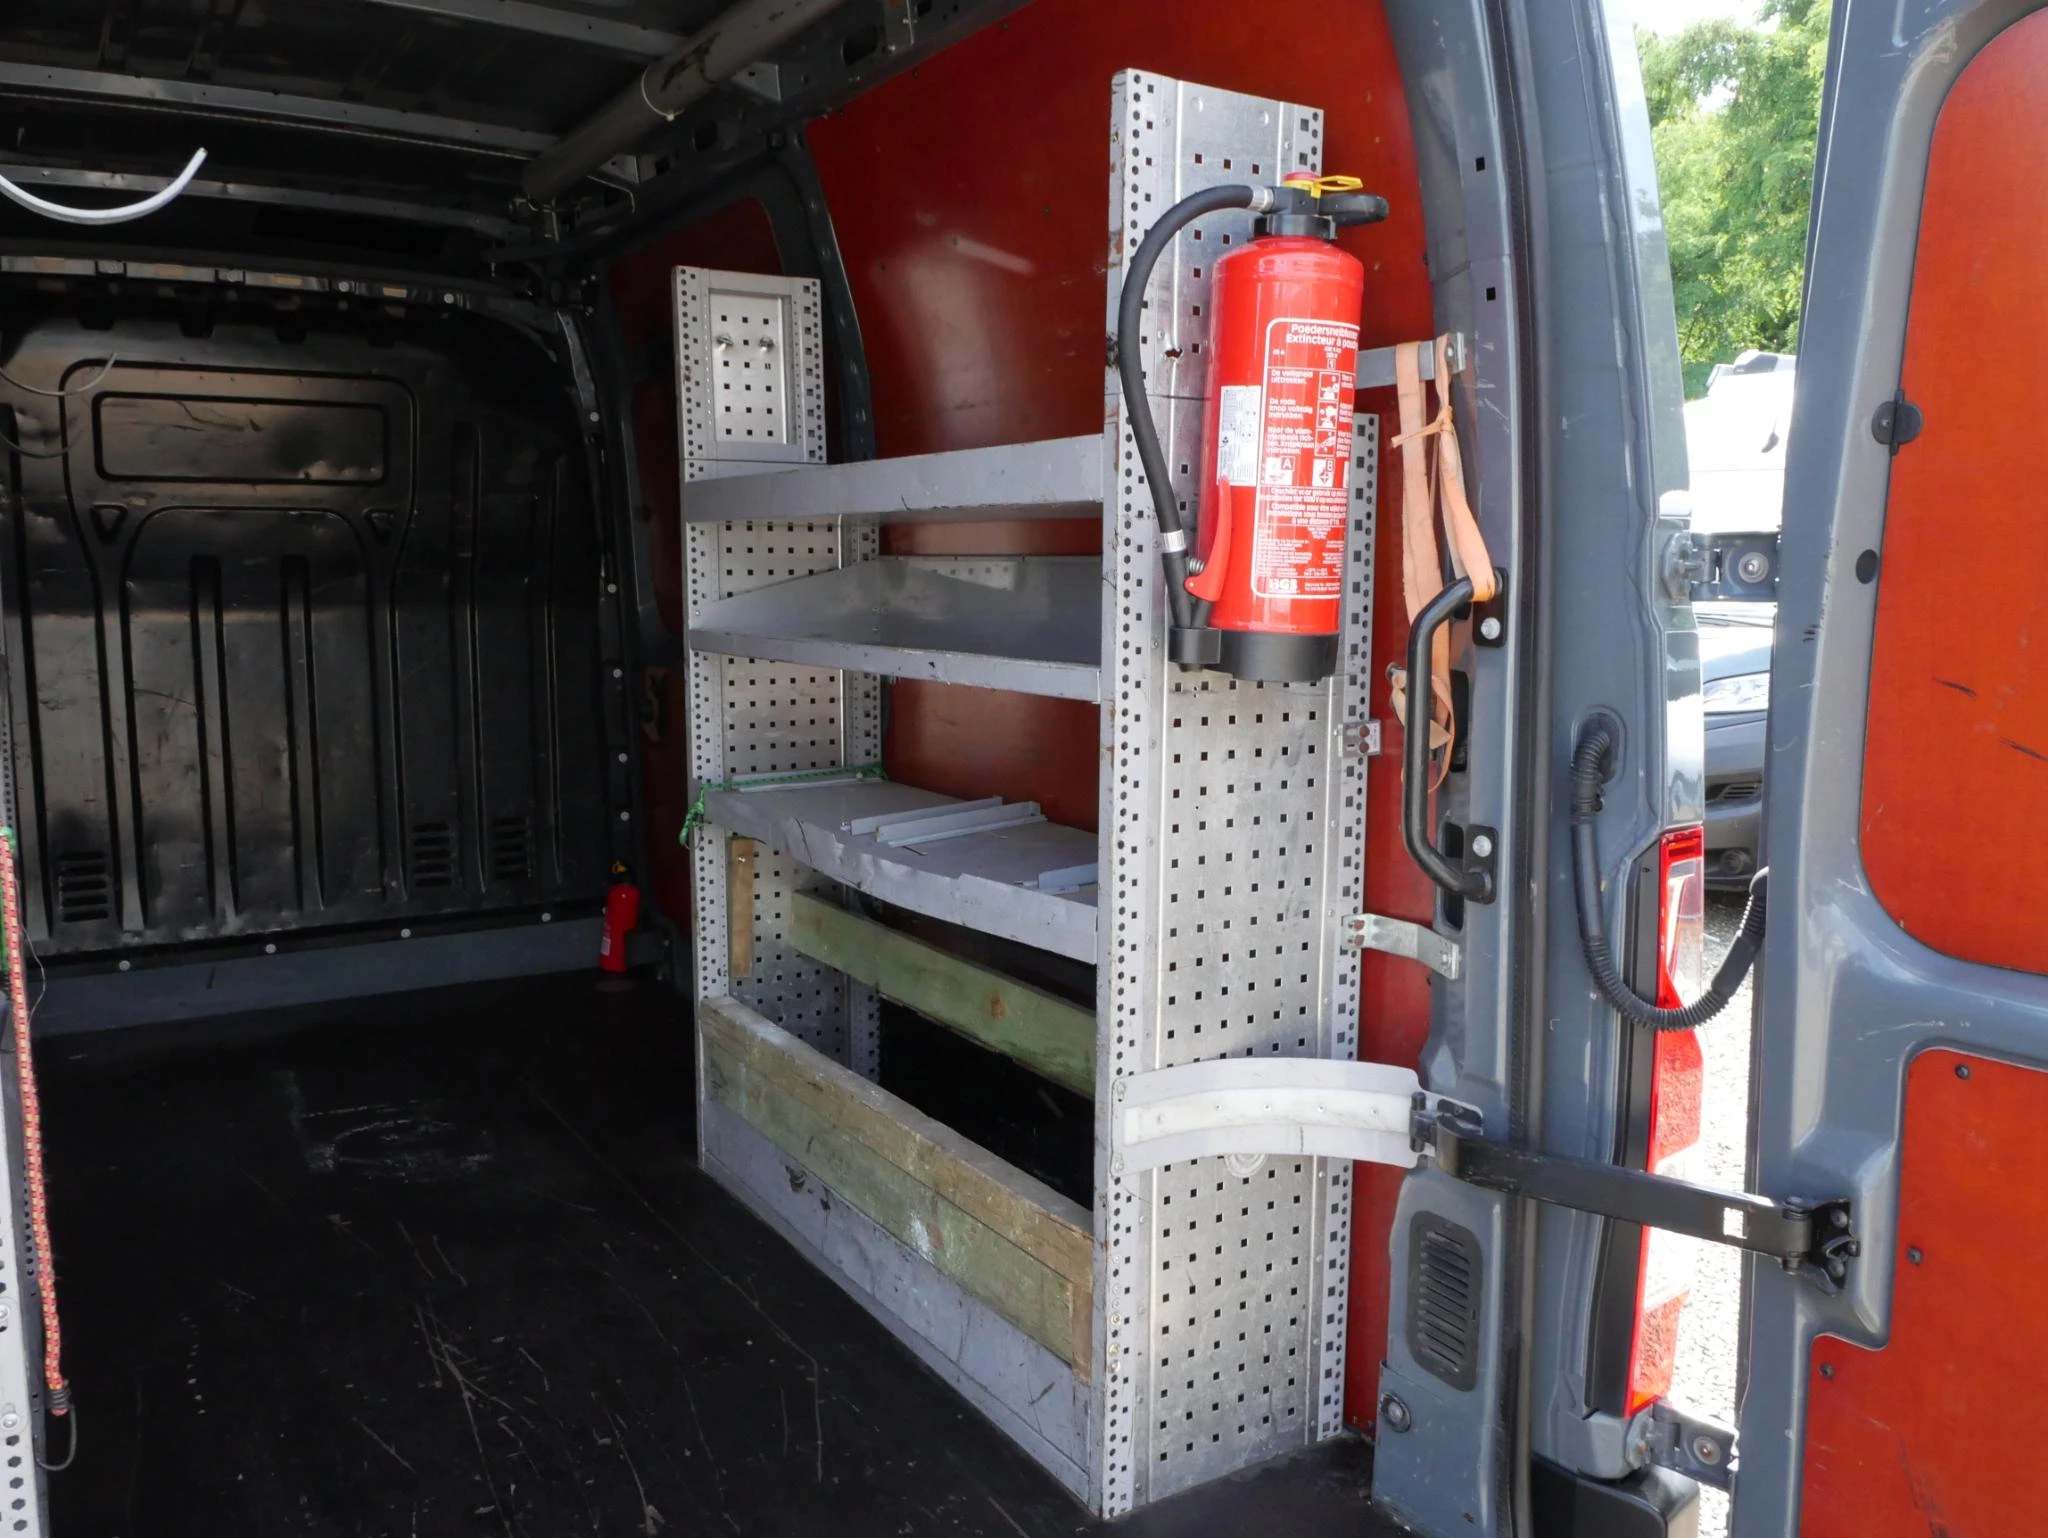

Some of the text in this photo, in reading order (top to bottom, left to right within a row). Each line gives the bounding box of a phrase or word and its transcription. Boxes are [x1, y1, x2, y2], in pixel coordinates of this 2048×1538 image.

[1286, 334, 1335, 345] Extincteur
[1283, 458, 1292, 469] A
[1327, 460, 1332, 471] B
